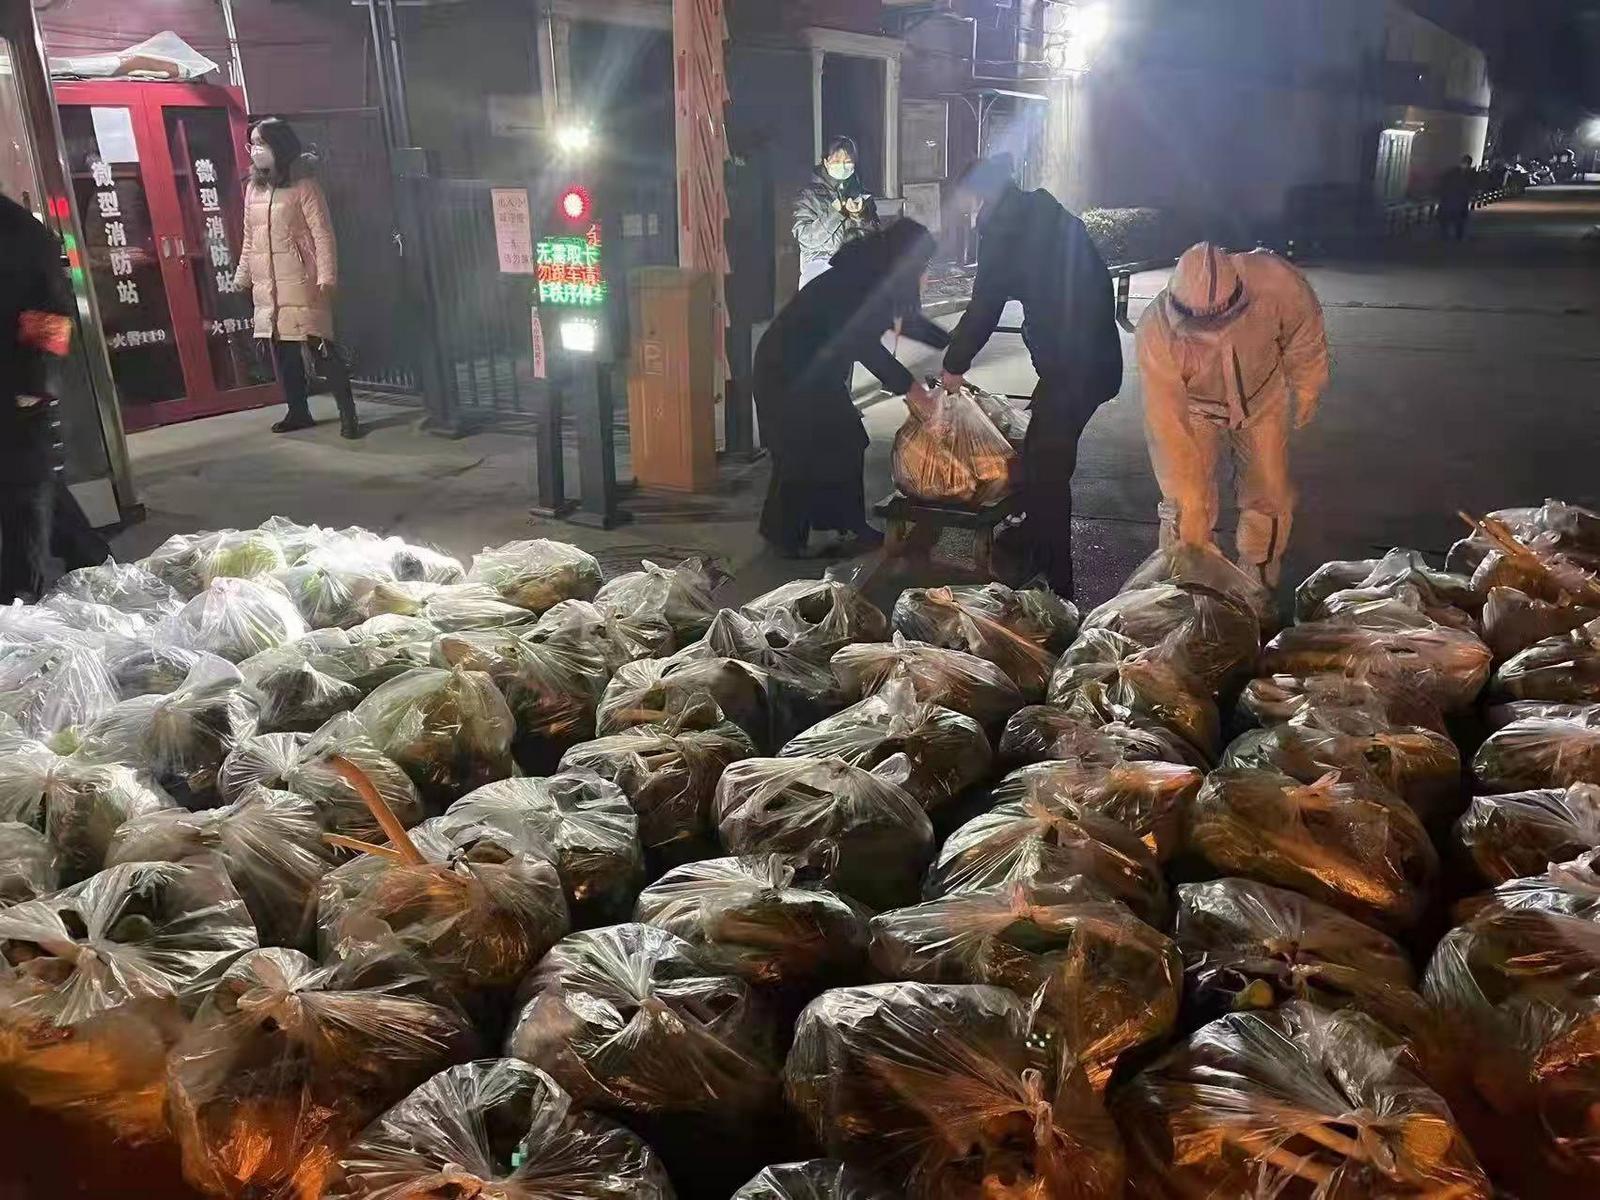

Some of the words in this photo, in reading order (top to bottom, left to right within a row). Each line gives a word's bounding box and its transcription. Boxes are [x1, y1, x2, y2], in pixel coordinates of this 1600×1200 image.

[91, 161, 139, 304] 微型消防站
[195, 159, 236, 294] 微型消防站
[113, 329, 166, 348] 火警119
